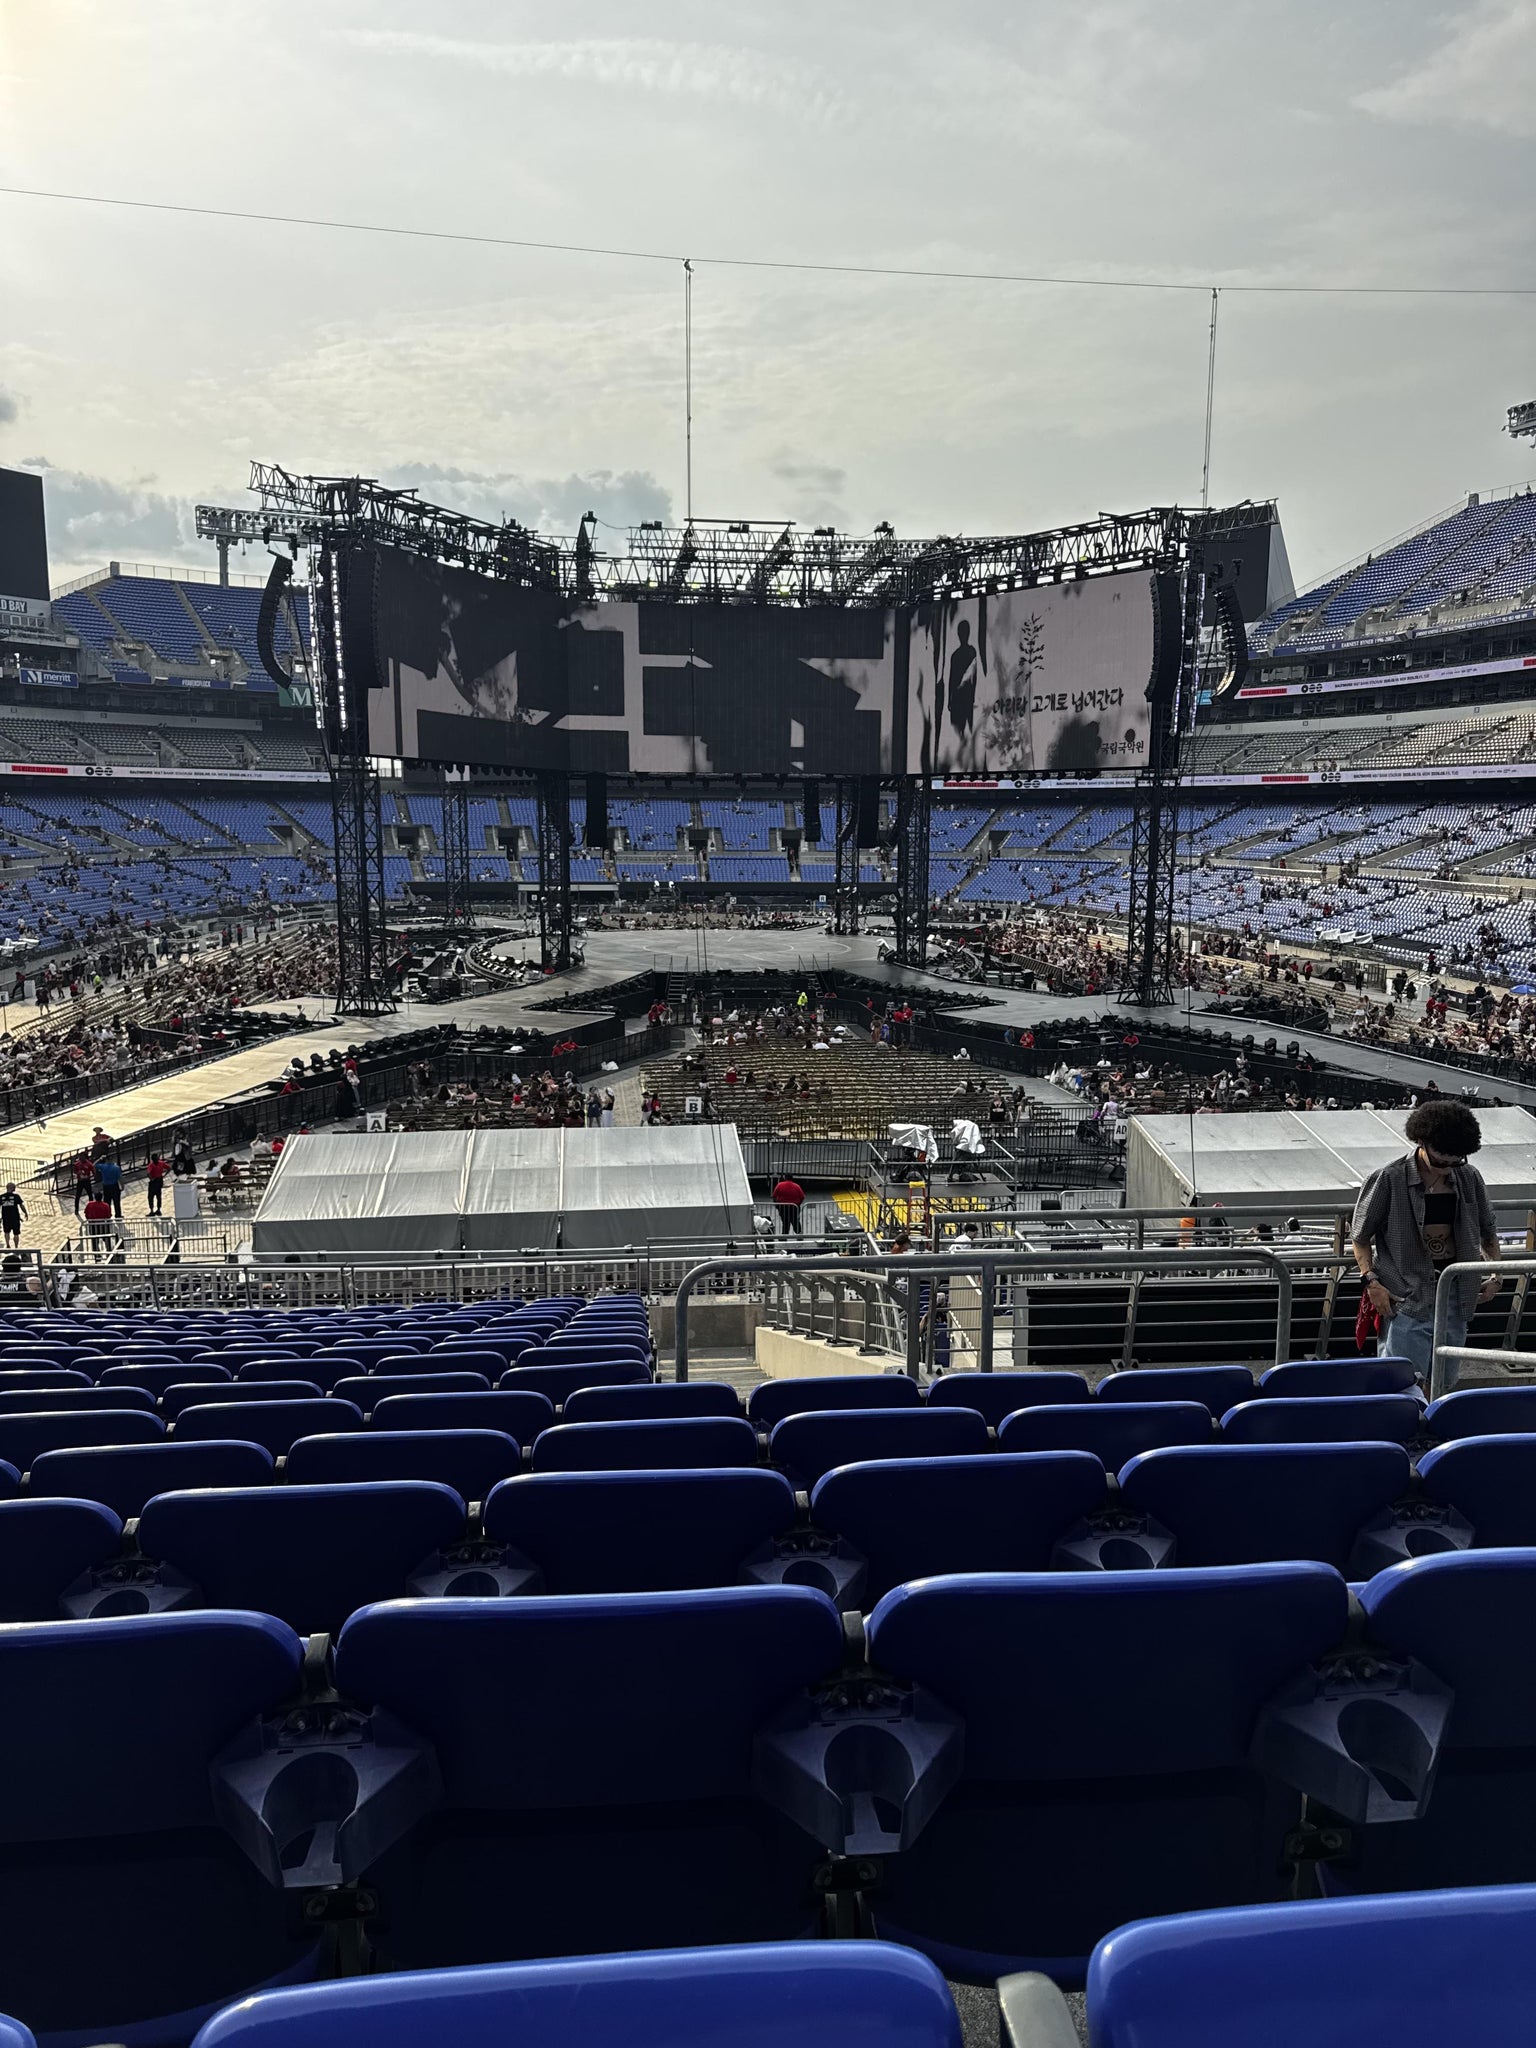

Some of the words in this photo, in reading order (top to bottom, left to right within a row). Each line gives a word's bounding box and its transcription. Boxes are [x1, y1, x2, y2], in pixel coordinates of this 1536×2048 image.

[8, 600, 25, 612] BAY
[44, 672, 72, 682] merritt
[992, 696, 1028, 718] 아리랑
[1031, 692, 1069, 713] 고개로
[1071, 686, 1124, 713] 넘어간다
[1100, 740, 1144, 756] 국립국악원
[690, 1103, 698, 1112] B
[370, 1120, 382, 1130] A
